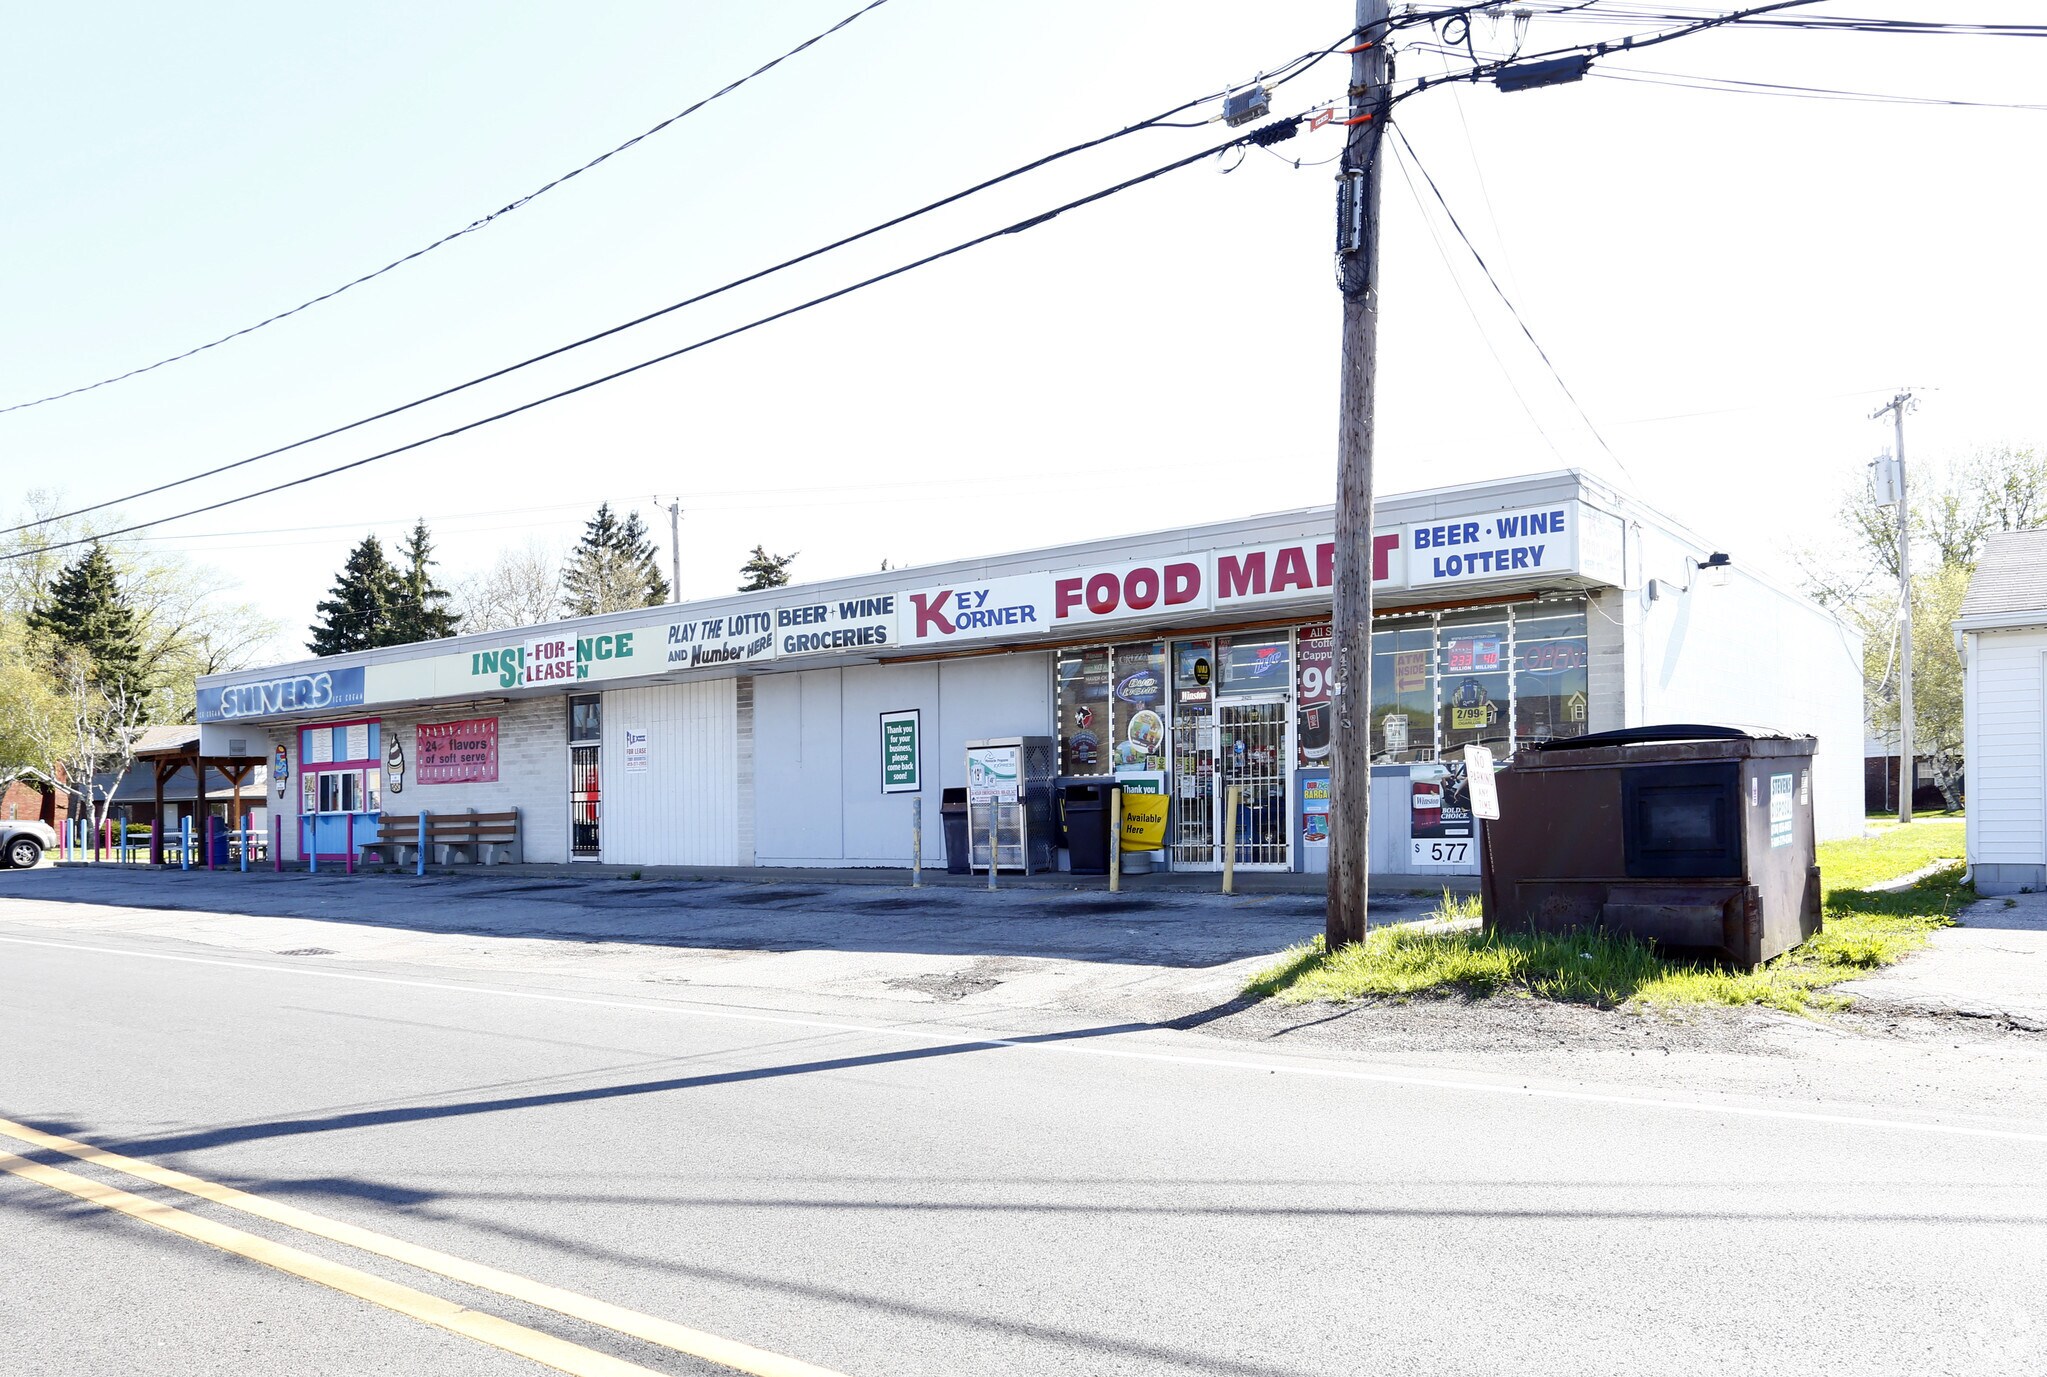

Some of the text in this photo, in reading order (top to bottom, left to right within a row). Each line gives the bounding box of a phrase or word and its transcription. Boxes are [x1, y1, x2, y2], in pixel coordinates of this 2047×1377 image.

[1414, 520, 1479, 549] BEER
[1495, 510, 1565, 540] WINE
[1432, 545, 1546, 577] LOTTERY
[1055, 562, 1201, 619] FOOD
[777, 596, 894, 628] BEER WINE
[667, 611, 771, 645] PLAY THE LOTTO
[1310, 627, 1324, 638] All
[783, 625, 888, 653] GROCERIES
[1310, 639, 1333, 649] Coffe
[667, 632, 773, 667] AND Number HERE
[1302, 651, 1333, 662] Cappu
[1397, 653, 1424, 666] ATM
[1450, 653, 1498, 667] 233 40
[1523, 645, 1583, 669] OPEN
[526, 660, 575, 682] LEASE
[220, 672, 333, 718] SHIVERS
[1181, 690, 1207, 701] Winston
[886, 725, 913, 735] Thank you
[449, 739, 487, 751] flavors
[890, 735, 911, 746] for your
[634, 747, 647, 755] LEASE
[889, 744, 912, 753] business,
[425, 753, 486, 764] of soft serve
[891, 754, 909, 763] please
[1473, 755, 1485, 769] NO
[887, 762, 914, 771] come back
[893, 771, 907, 780] soon!
[1122, 784, 1156, 794] Thank you
[1771, 776, 1792, 796] STEVENS
[1304, 789, 1329, 799] BARGA
[1416, 796, 1439, 805] Winston
[1126, 812, 1162, 823] Available
[1126, 824, 1144, 834] Here
[1414, 843, 1468, 862] $ 5.77
